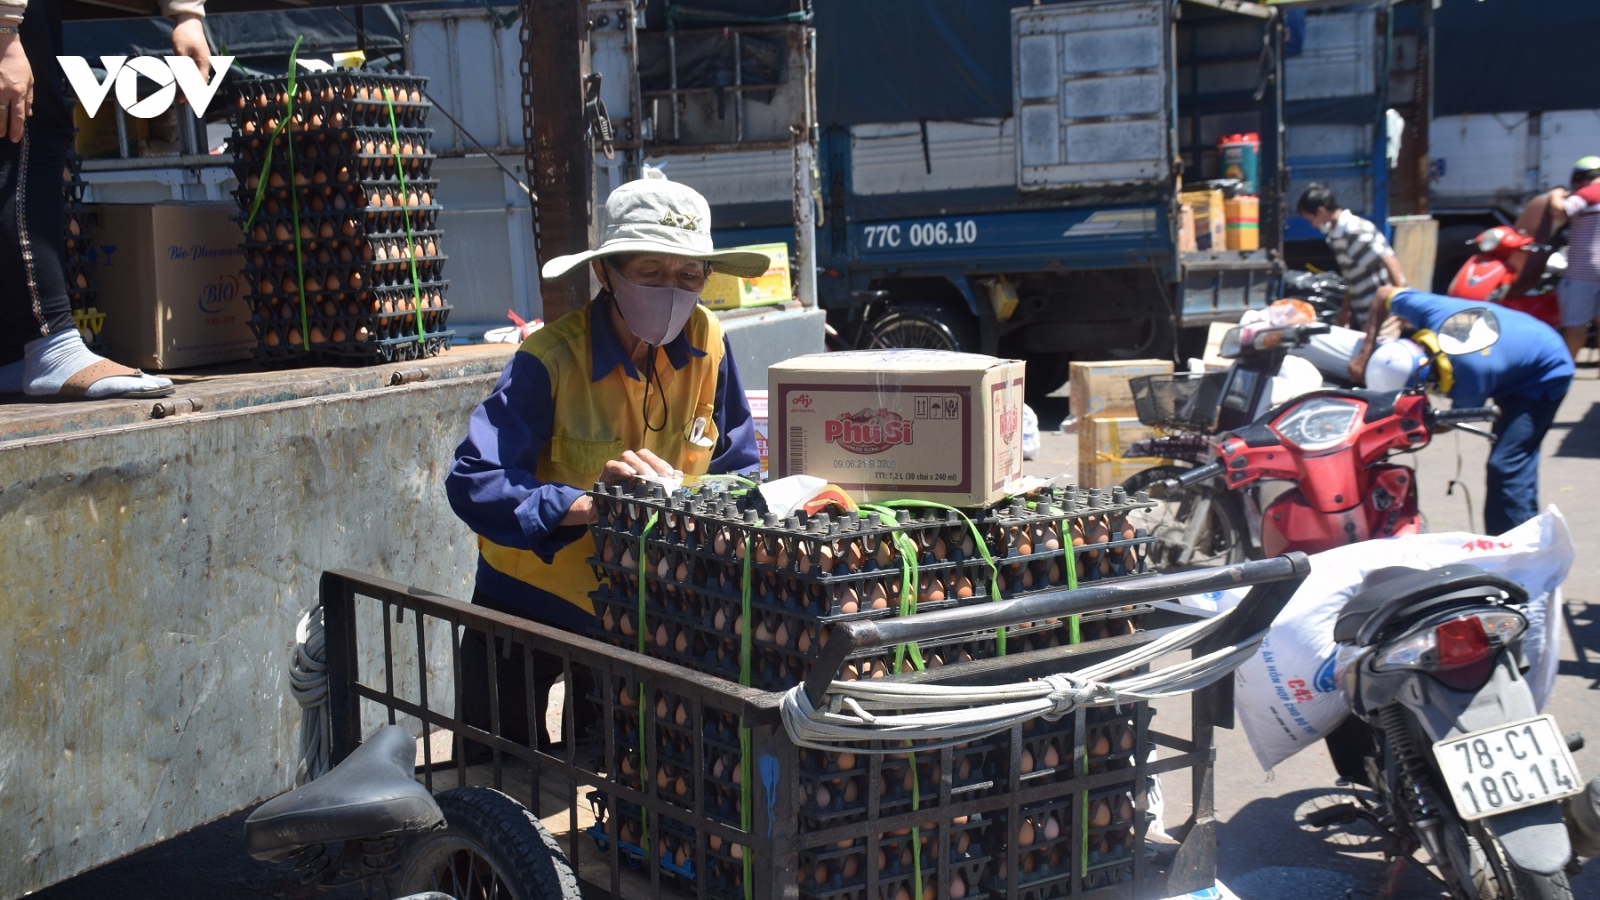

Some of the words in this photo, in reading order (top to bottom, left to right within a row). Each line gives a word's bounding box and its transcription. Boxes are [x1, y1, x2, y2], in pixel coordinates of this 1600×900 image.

[864, 224, 901, 248] 77C
[909, 220, 977, 246] 006.10
[825, 419, 883, 444] Phú
[833, 460, 867, 469] 09.06.21
[889, 472, 898, 480] 7,2
[905, 472, 915, 480] (30
[935, 473, 946, 481] 240
[1284, 702, 1300, 717] CHO
[1462, 758, 1573, 813] 180.14
